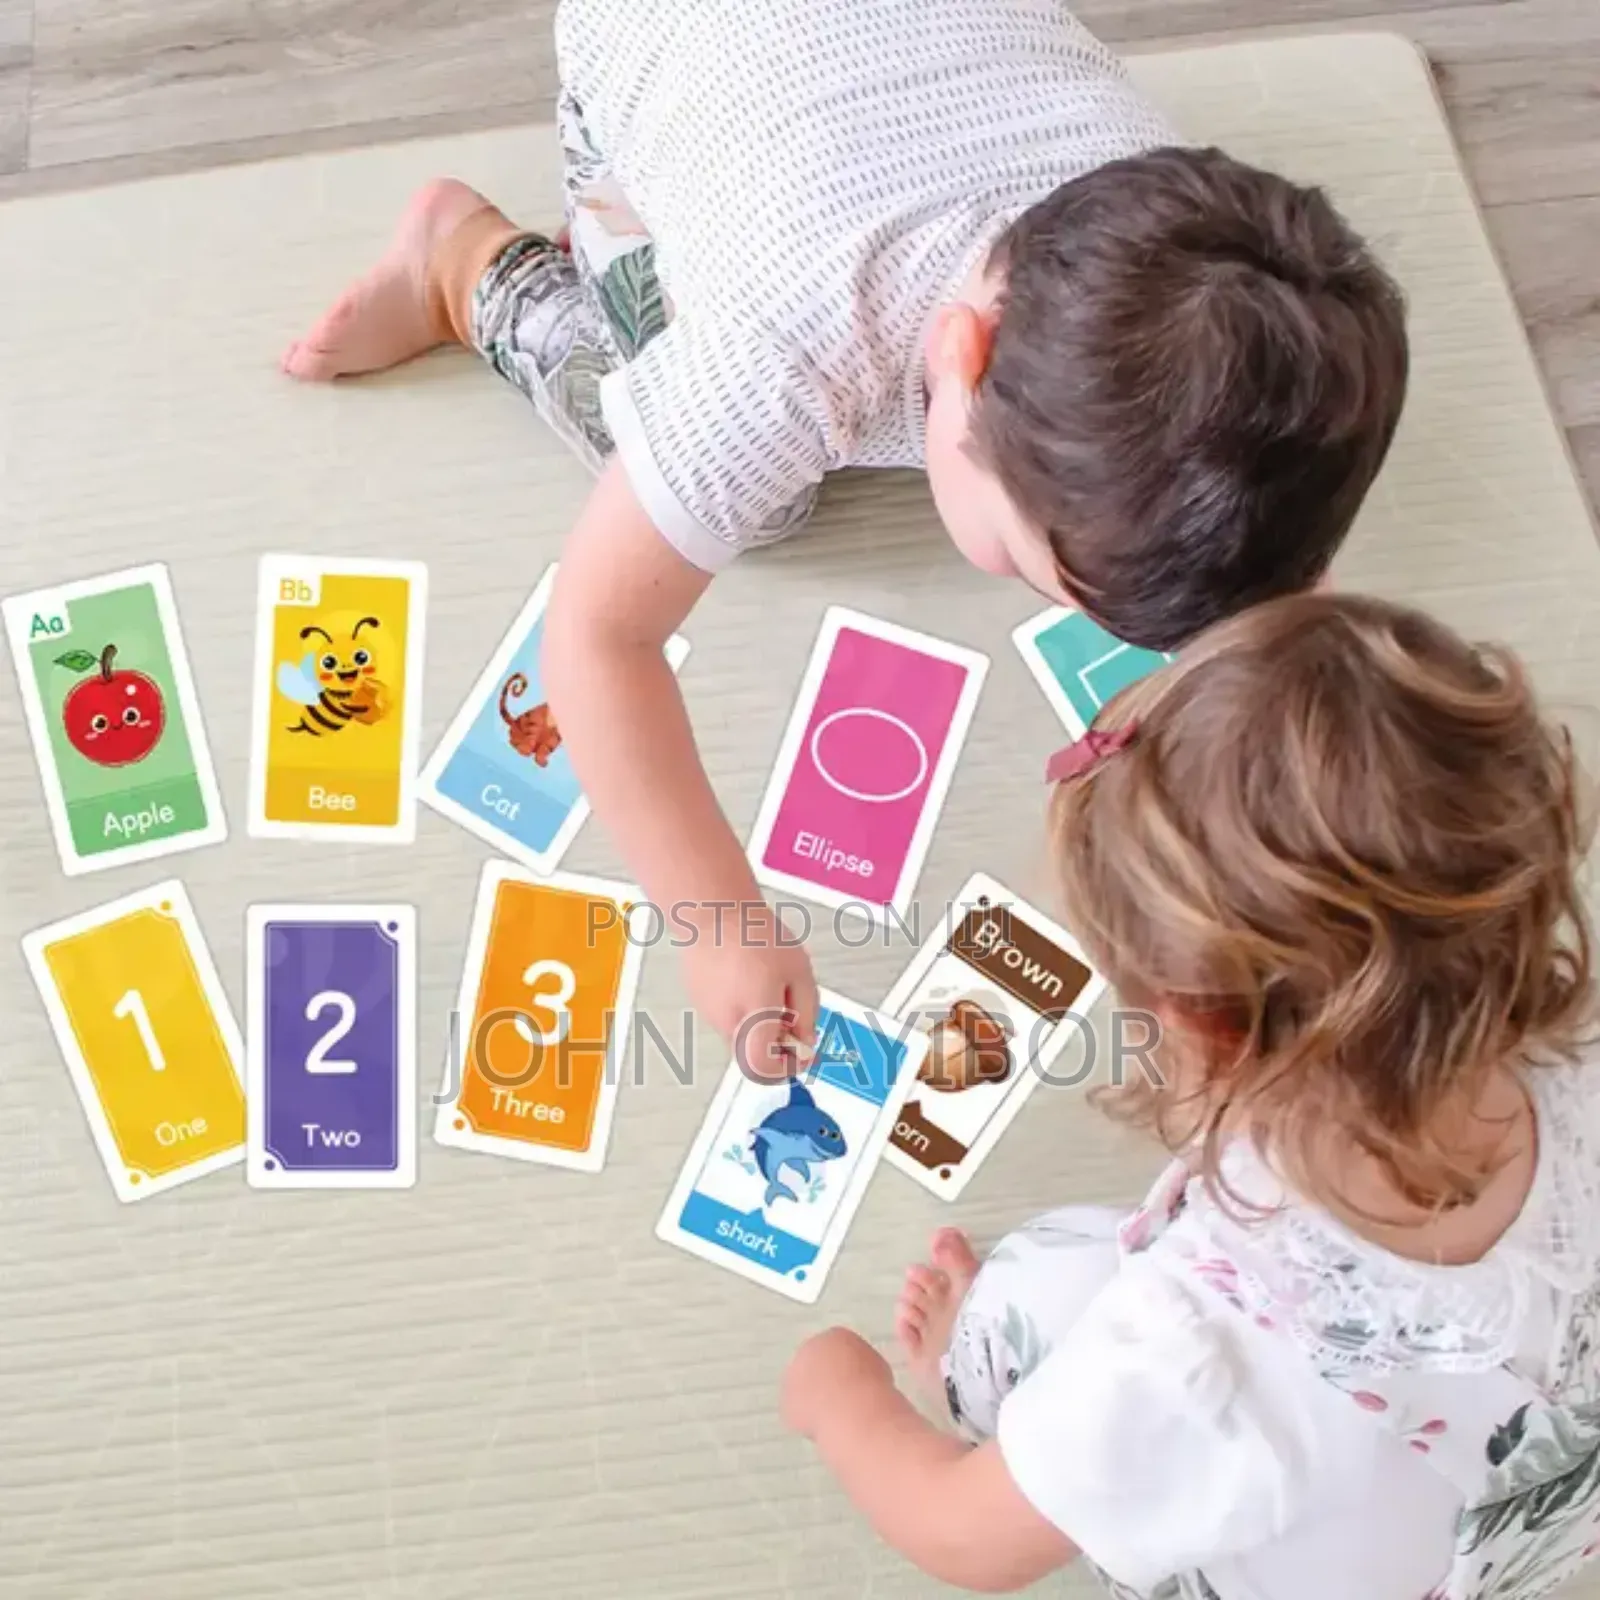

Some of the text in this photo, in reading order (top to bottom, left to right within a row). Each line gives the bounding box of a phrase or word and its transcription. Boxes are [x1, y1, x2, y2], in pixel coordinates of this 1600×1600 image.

[279, 577, 312, 602] Bb
[30, 613, 65, 638] Aa
[308, 786, 356, 811] Bee
[480, 784, 520, 822] Cat
[102, 803, 175, 838] Apple
[792, 830, 875, 878] Ellipse
[973, 919, 1063, 998] Brown
[513, 959, 576, 1047] 3
[113, 989, 166, 1071] 1
[305, 990, 357, 1074] 2
[490, 1086, 567, 1124] Three
[155, 1117, 208, 1146] One
[301, 1123, 361, 1148] Two
[894, 1121, 930, 1152] orn
[715, 1219, 778, 1258] shark
